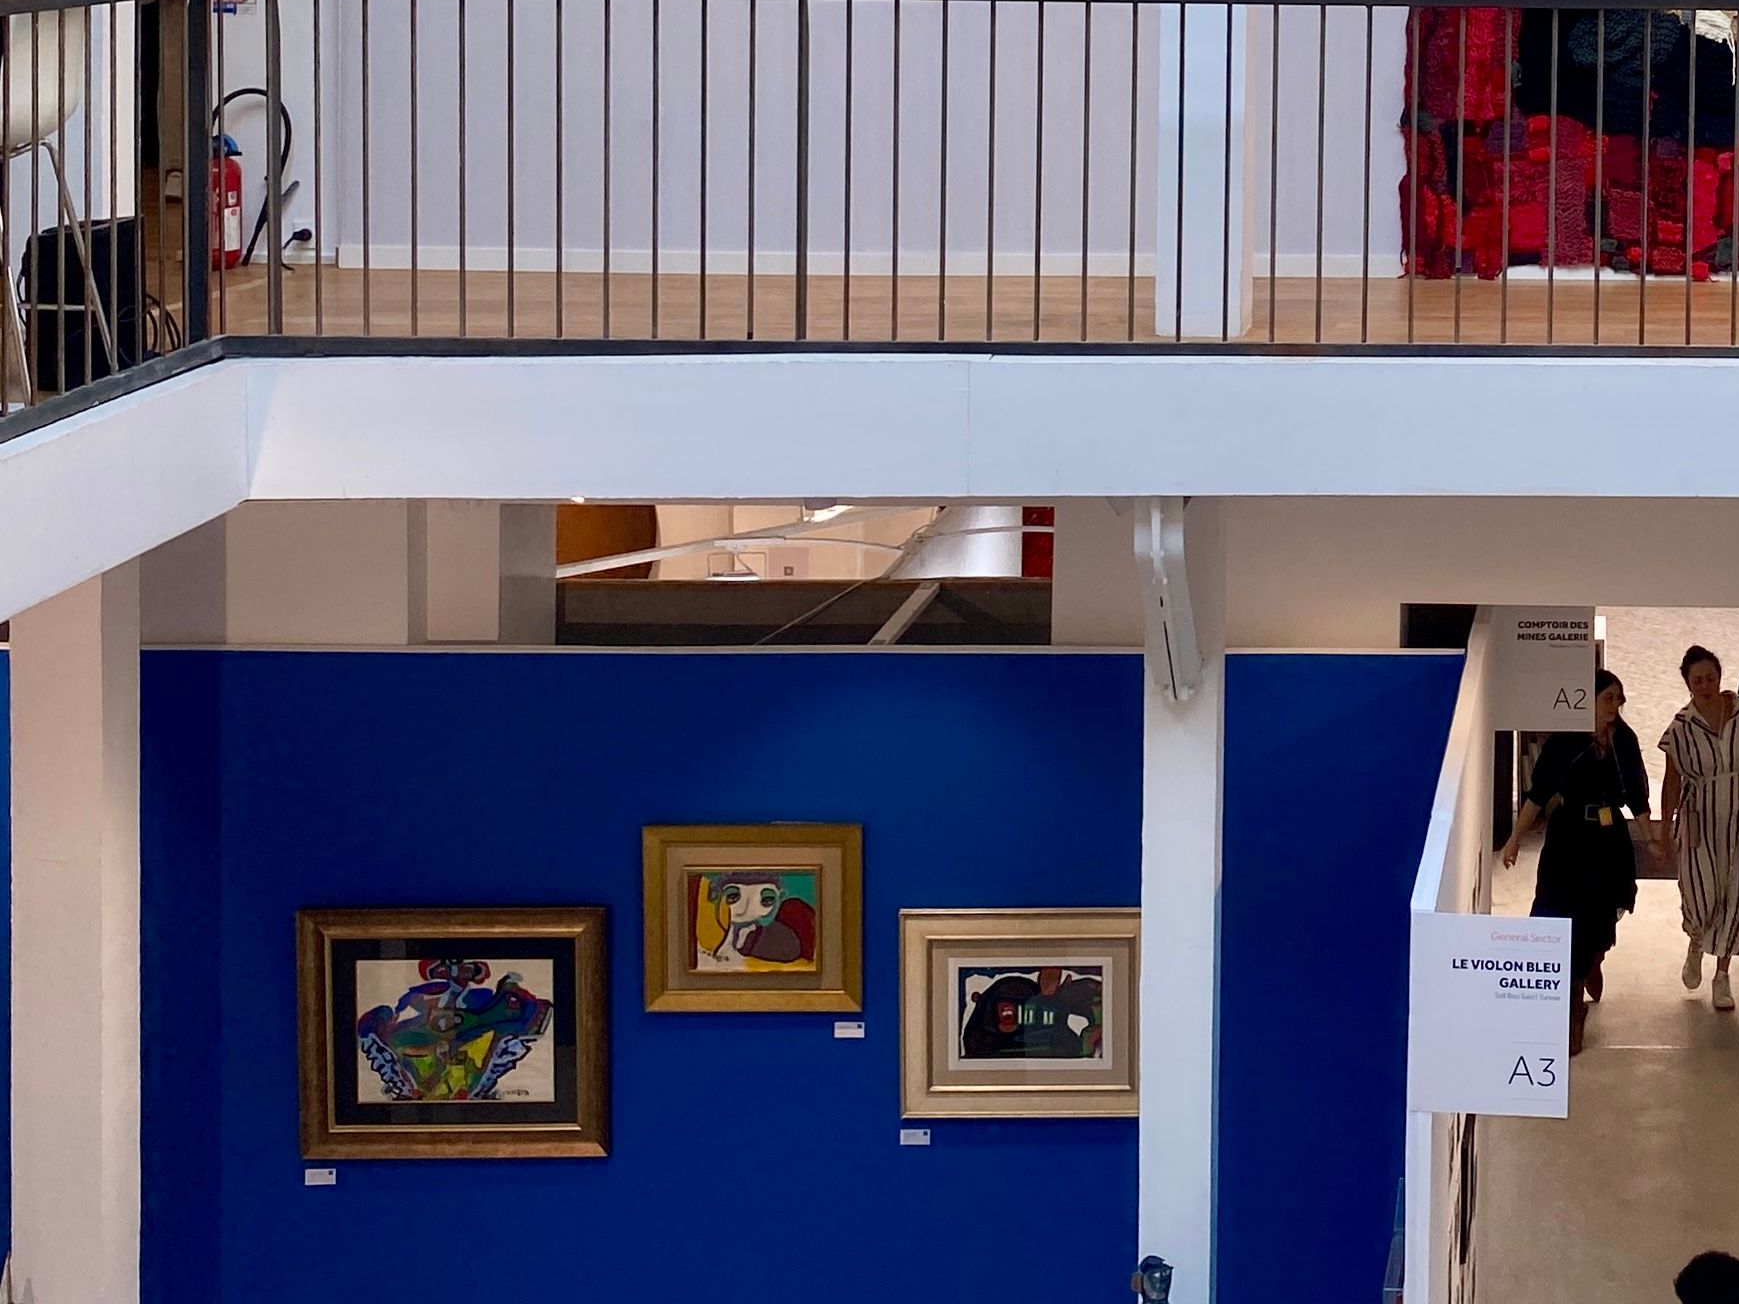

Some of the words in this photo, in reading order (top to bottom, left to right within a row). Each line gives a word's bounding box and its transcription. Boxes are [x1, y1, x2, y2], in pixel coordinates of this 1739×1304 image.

[1518, 621, 1568, 629] COMPTOIR
[1570, 621, 1589, 630] DES
[1517, 633, 1547, 641] MINES
[1548, 633, 1589, 641] GALERIE
[1553, 687, 1587, 710] A2
[1490, 931, 1530, 942] General
[1530, 933, 1562, 944] Sector
[1452, 958, 1469, 970] LE
[1471, 959, 1524, 972] VIOLON
[1526, 962, 1561, 974] BLEU
[1499, 977, 1561, 990] GALLERY
[1508, 1055, 1557, 1087] A3
